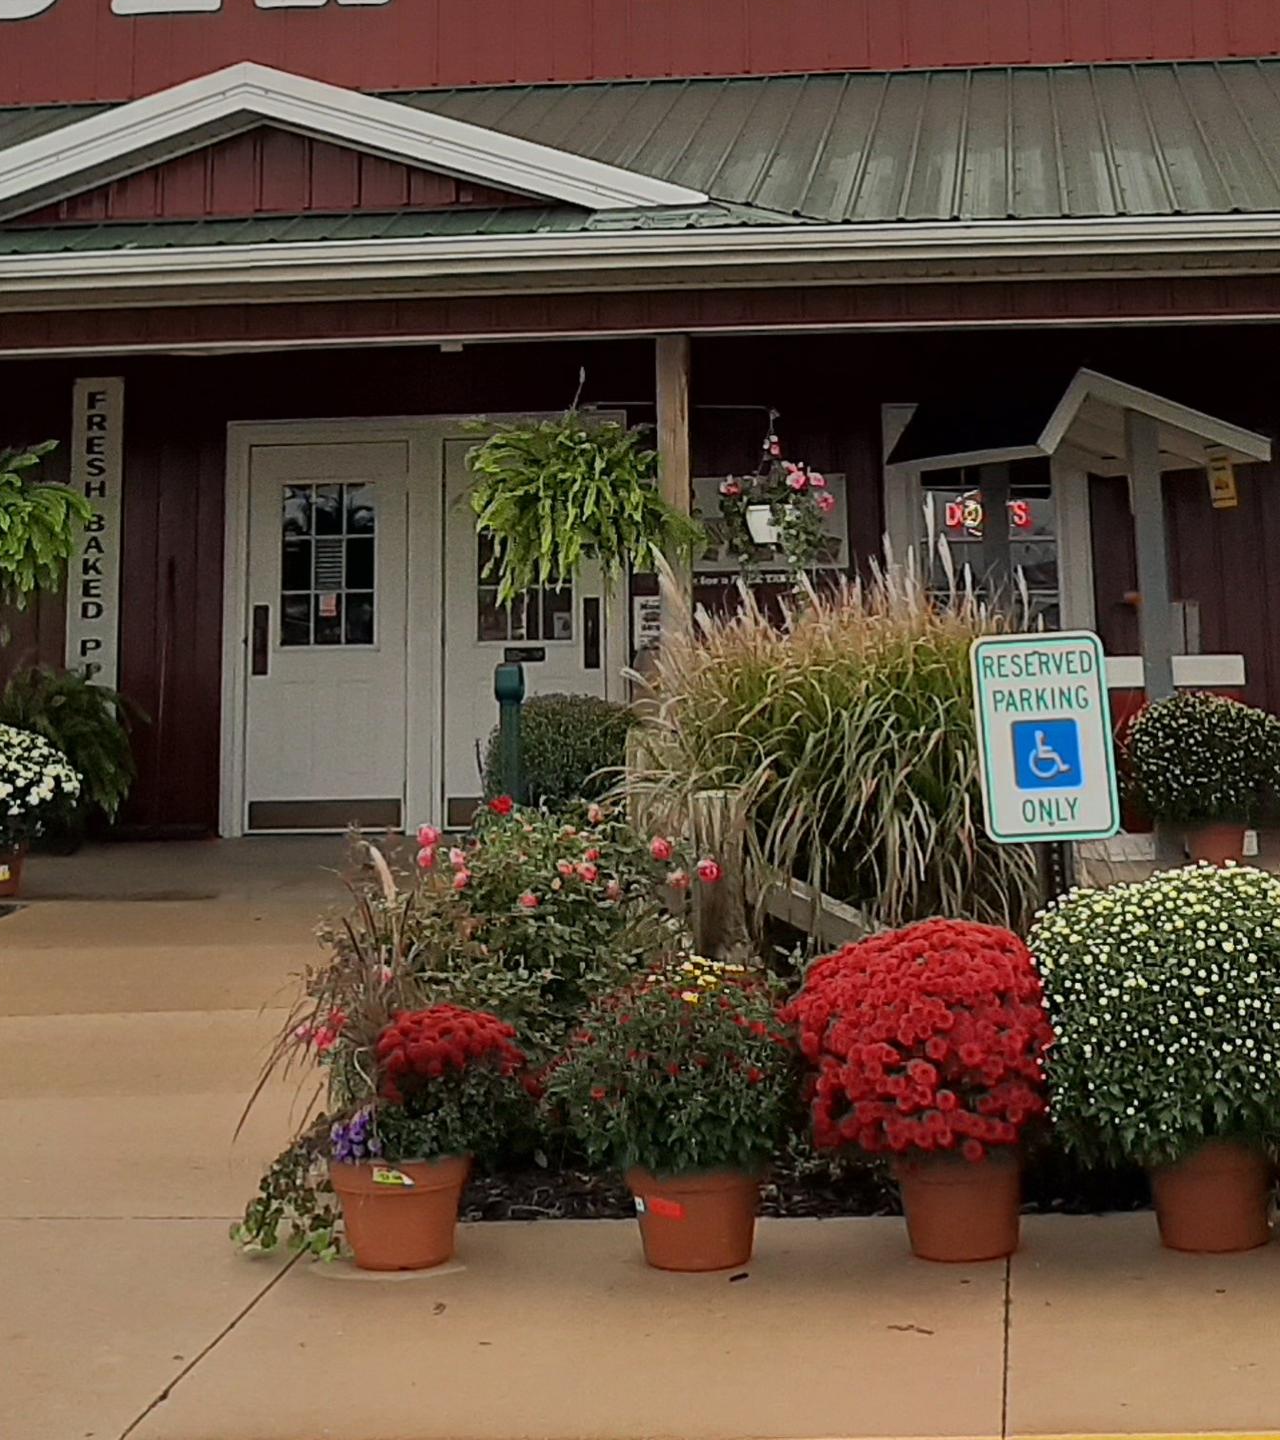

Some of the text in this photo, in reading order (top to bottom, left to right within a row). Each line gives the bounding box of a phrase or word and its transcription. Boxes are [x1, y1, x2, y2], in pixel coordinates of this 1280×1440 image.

[84, 390, 108, 499] FRESH
[79, 513, 106, 620] BAKED
[982, 650, 1093, 679] RESERVED
[992, 685, 1090, 712] PARKING
[1022, 797, 1078, 823] ONLY
